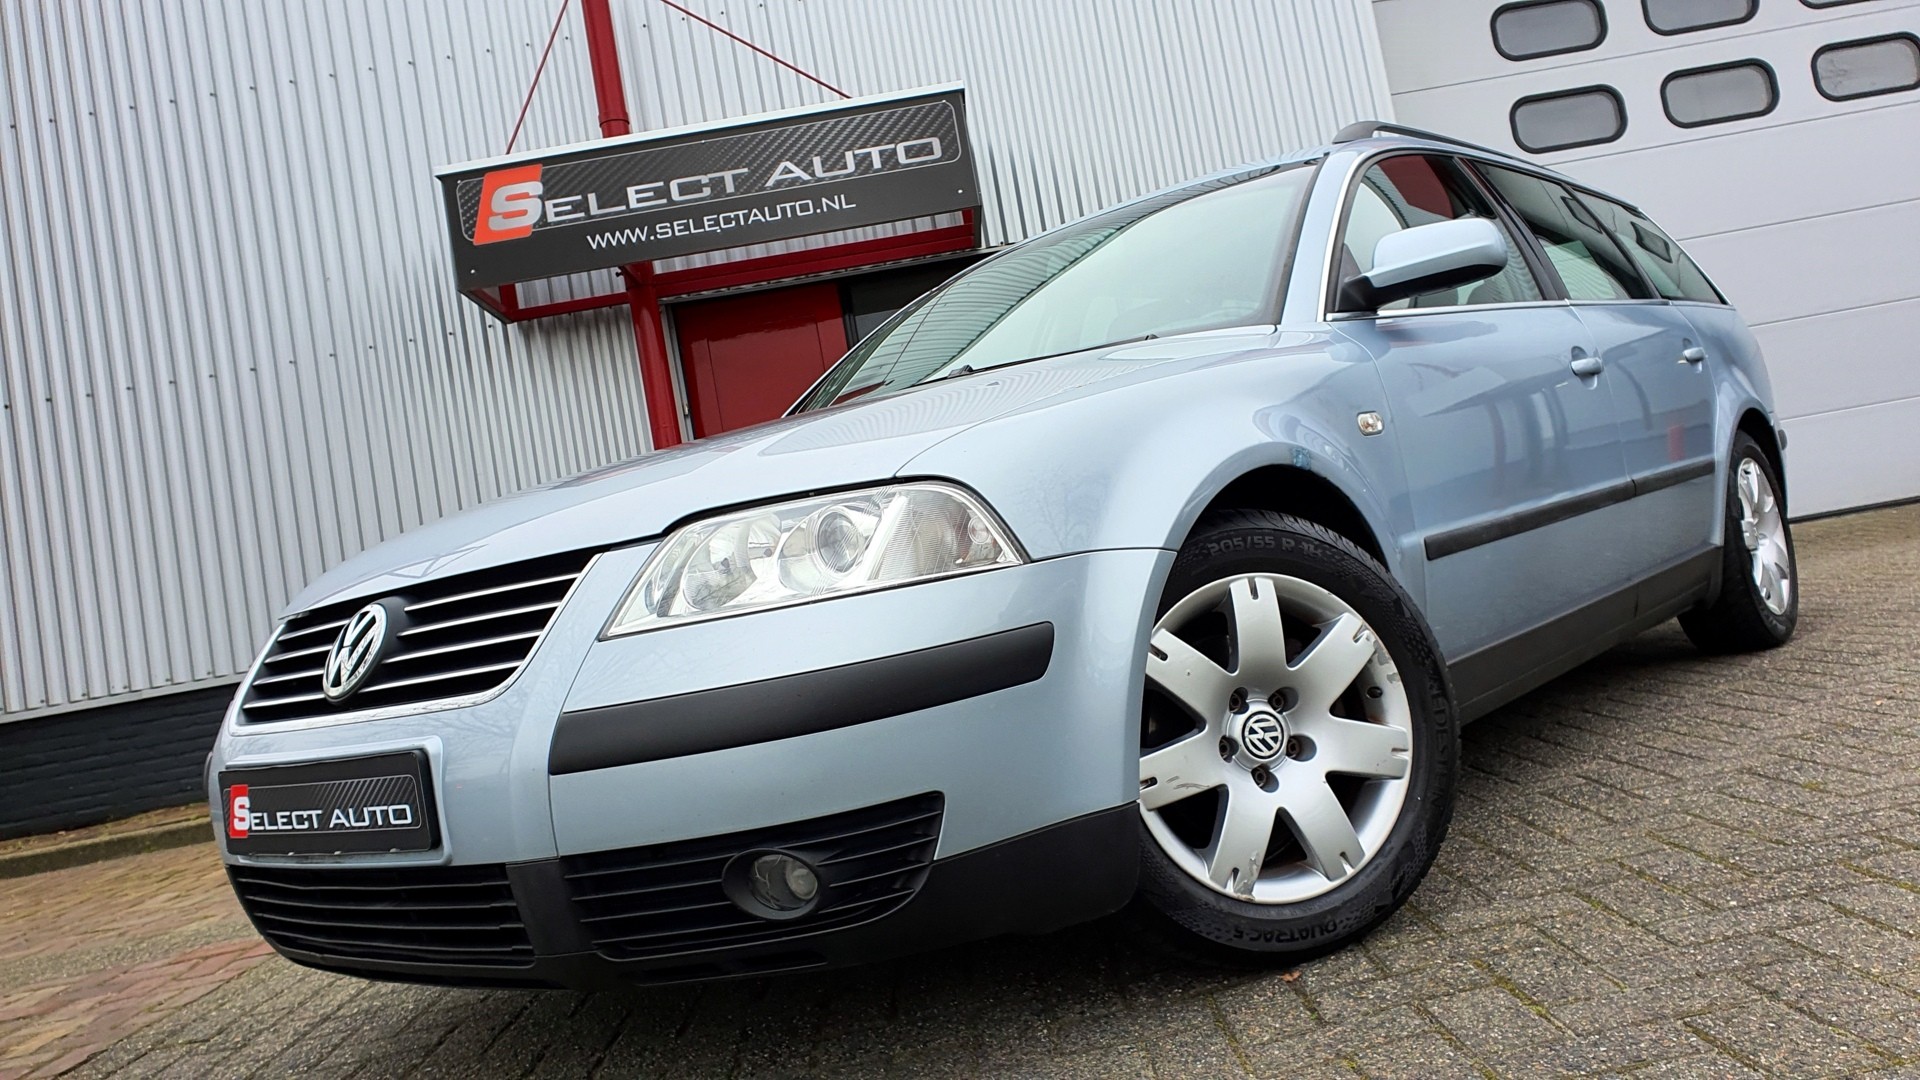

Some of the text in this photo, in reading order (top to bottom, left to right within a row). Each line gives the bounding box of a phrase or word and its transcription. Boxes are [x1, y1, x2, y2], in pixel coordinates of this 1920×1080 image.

[487, 136, 943, 232] SELECT AUTO
[586, 193, 857, 252] WWW.SELECTAUTO.NL
[1206, 535, 1275, 557] 205/55
[233, 796, 413, 832] SELECT AUTO
